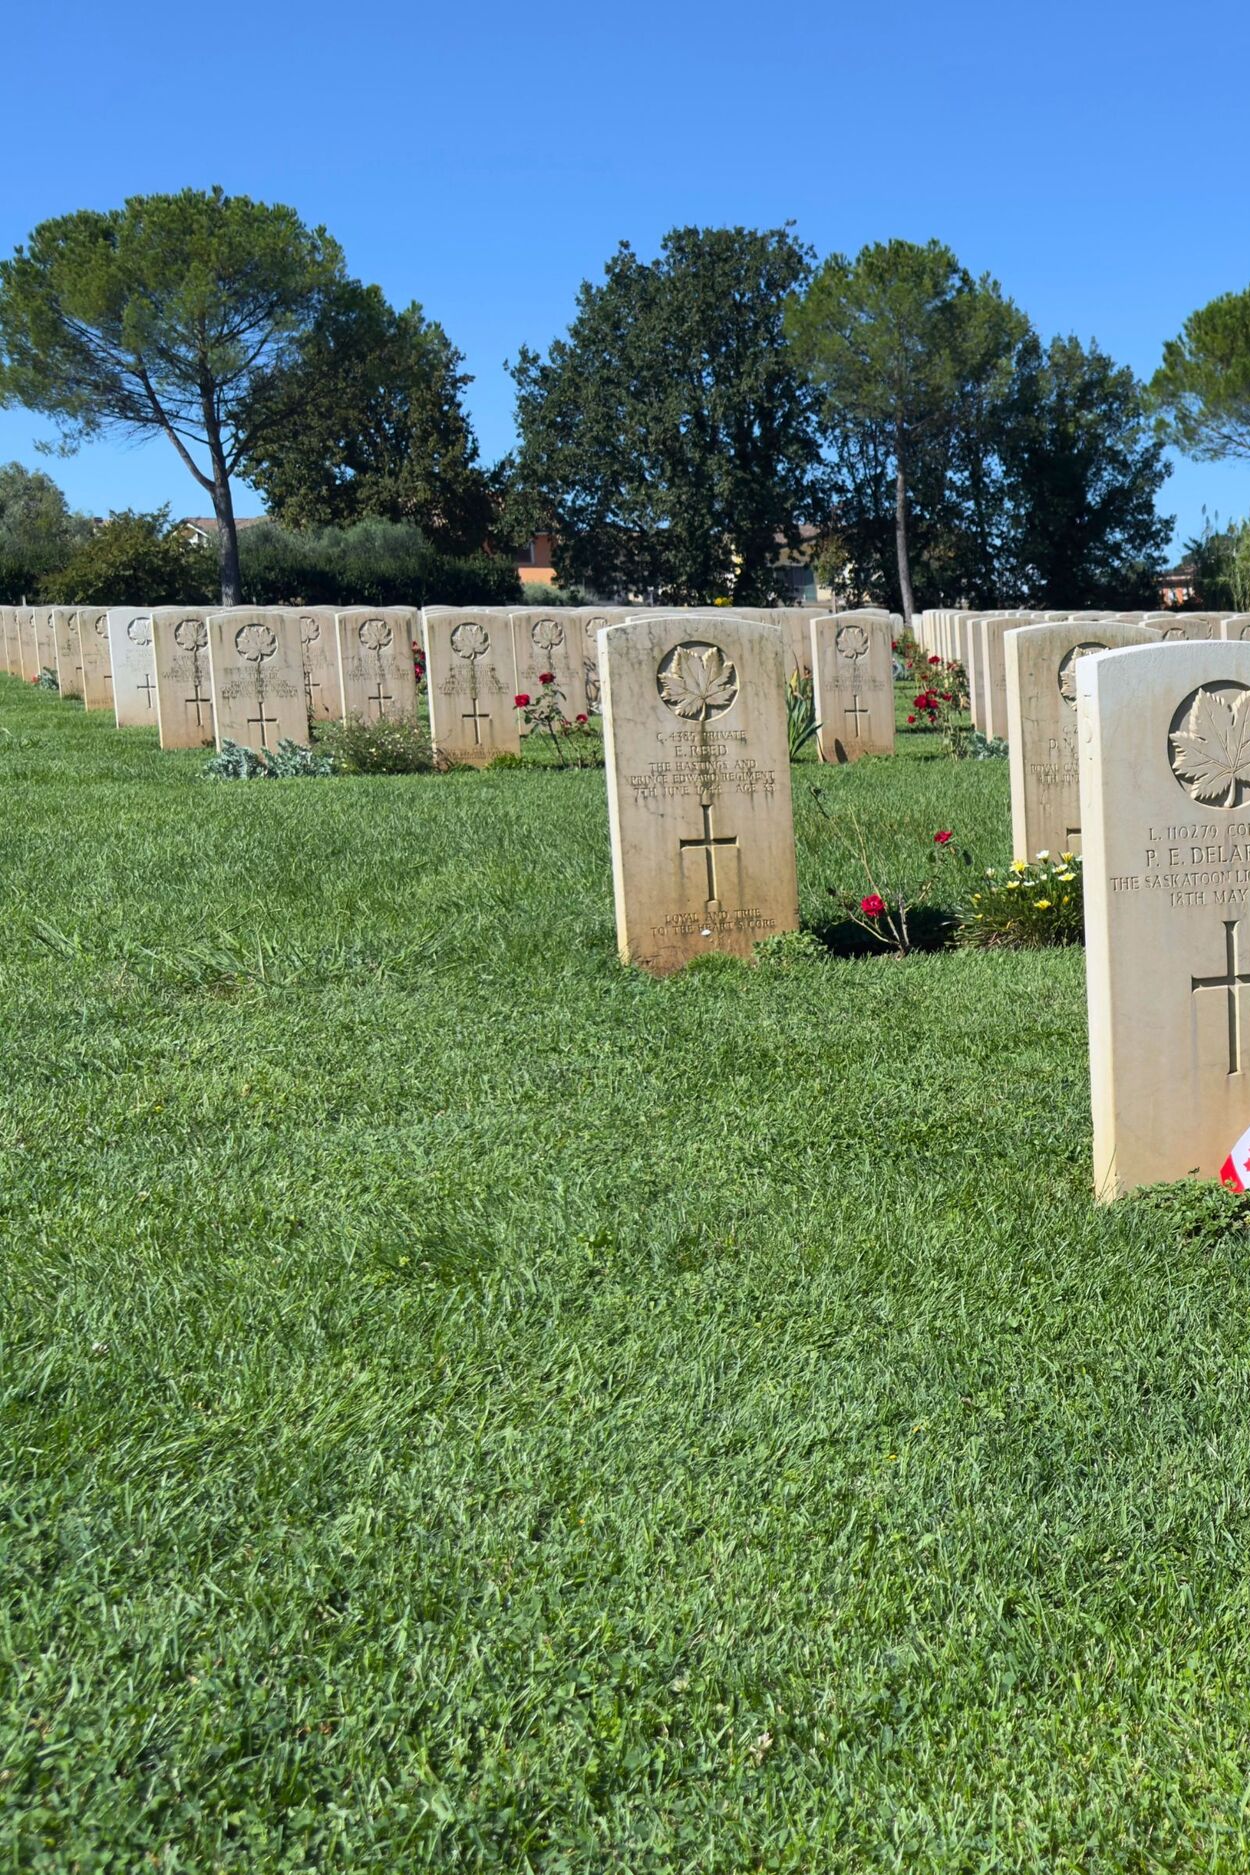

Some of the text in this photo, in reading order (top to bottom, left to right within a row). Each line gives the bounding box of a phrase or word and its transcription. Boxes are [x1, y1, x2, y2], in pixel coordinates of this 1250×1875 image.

[704, 730, 747, 740] PRIVATE
[675, 744, 728, 757] E. REED
[649, 759, 757, 772] THE HASTINGS AND
[630, 771, 775, 785] PRINCE EDWARD REGIMENT
[1149, 827, 1162, 841] L.
[1146, 849, 1159, 867] P.
[1169, 847, 1185, 866] E.
[1110, 876, 1140, 892] THE
[1144, 871, 1231, 889] SASKATOON
[1170, 892, 1206, 907] 18TH
[1214, 889, 1249, 905] MAY
[665, 908, 761, 925] LOYAL AND TRUE
[650, 927, 668, 938] TO
[674, 925, 693, 934] THE
[748, 919, 776, 928] CORE
